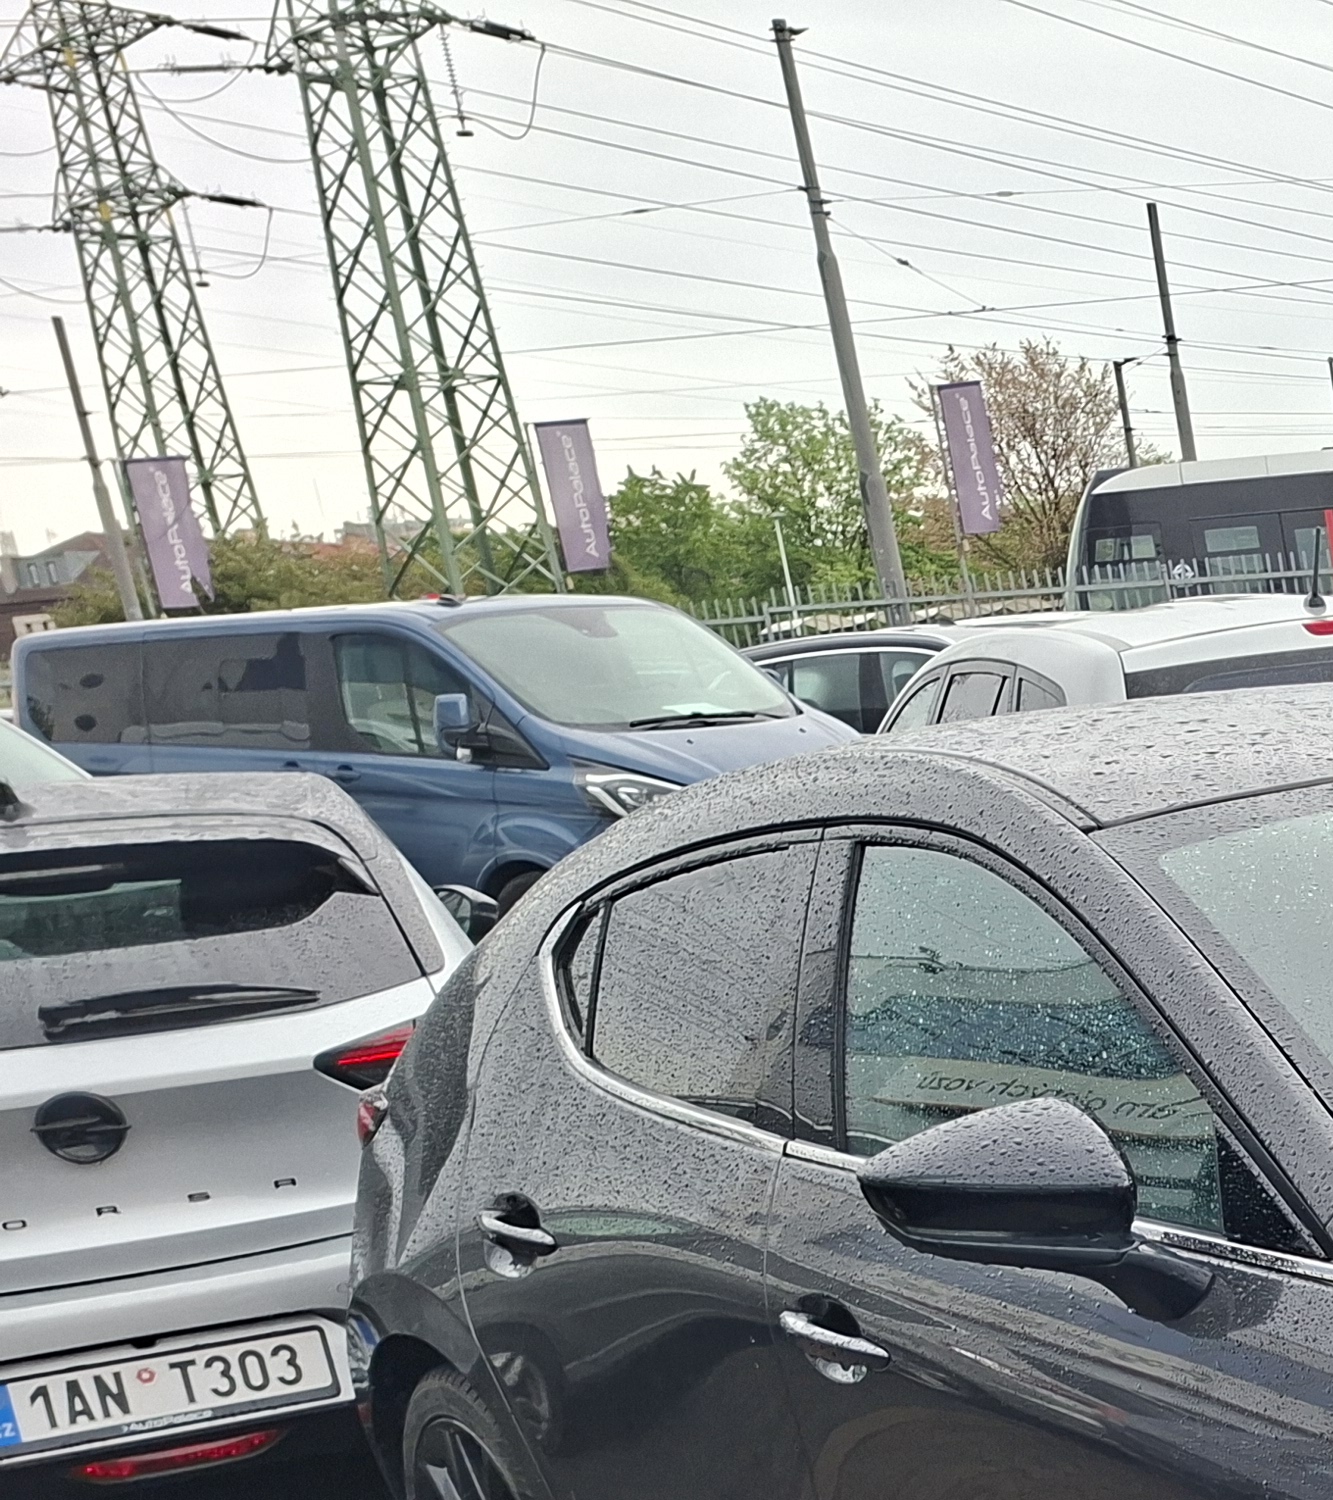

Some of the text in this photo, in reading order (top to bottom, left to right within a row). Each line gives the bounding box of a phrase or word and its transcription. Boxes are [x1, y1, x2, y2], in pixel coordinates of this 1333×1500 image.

[561, 434, 599, 558] AutoPalace
[959, 397, 993, 521] AutoPalace
[29, 1343, 303, 1430] 1AN T303
